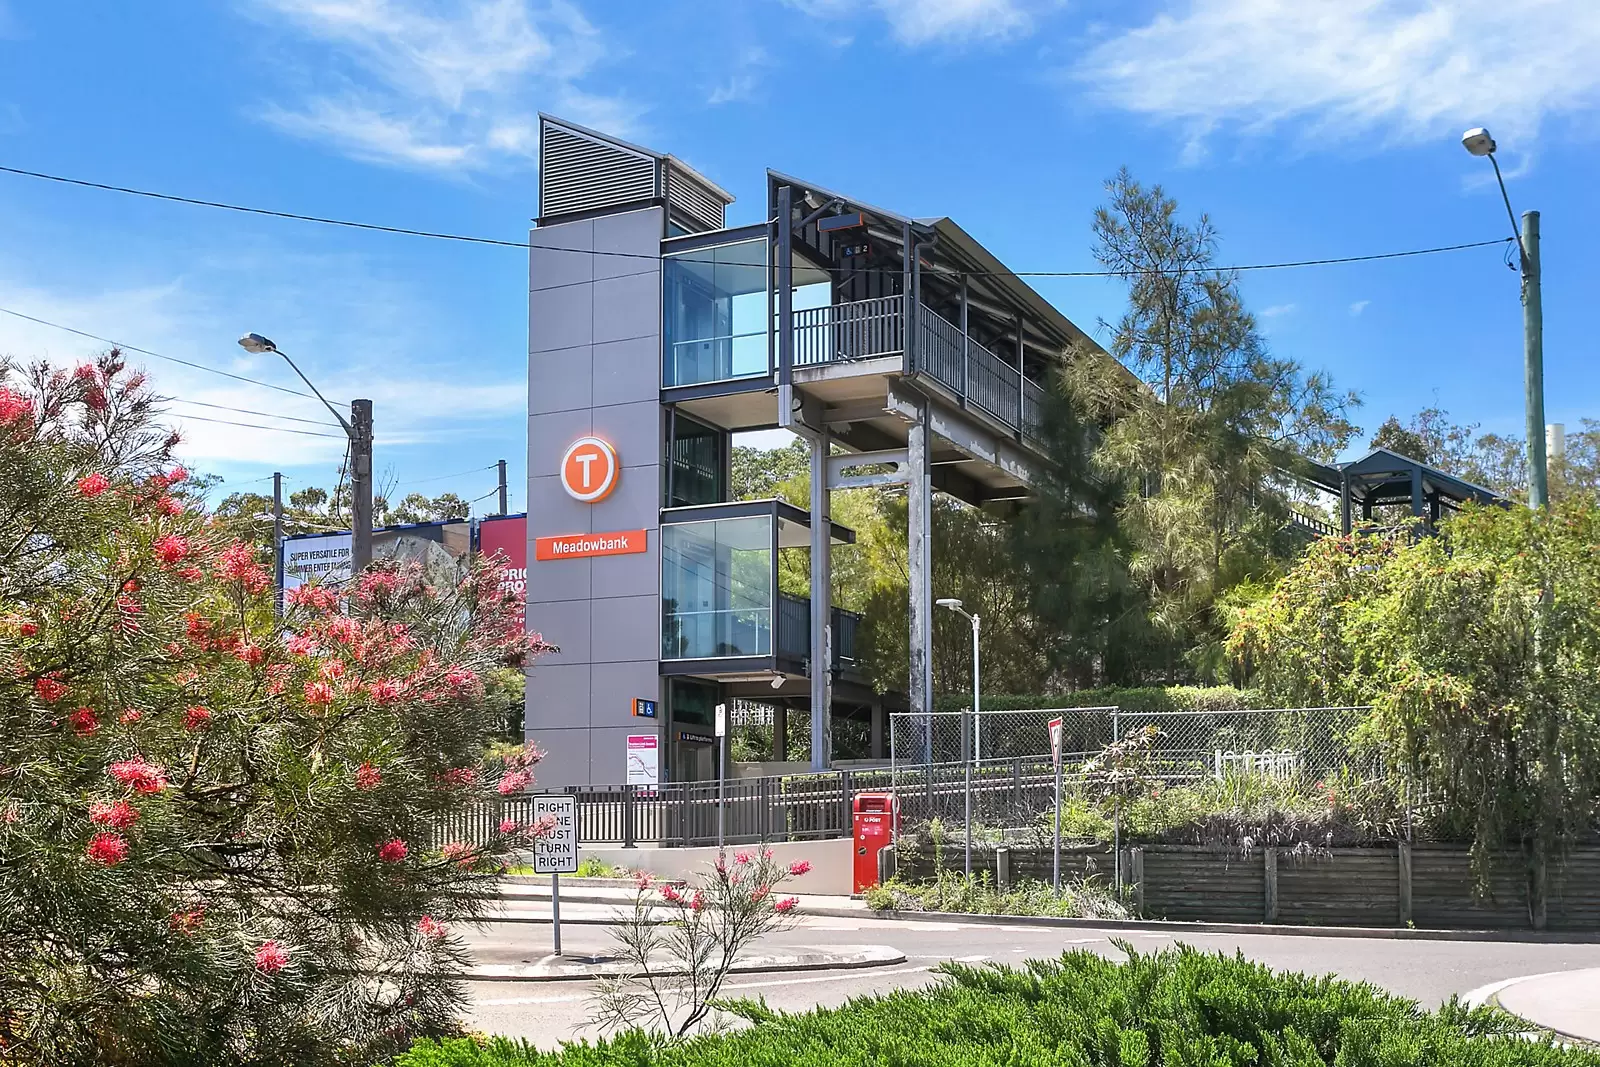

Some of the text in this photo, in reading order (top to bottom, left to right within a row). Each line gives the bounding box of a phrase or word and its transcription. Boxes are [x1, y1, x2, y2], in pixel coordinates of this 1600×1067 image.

[575, 453, 598, 488] T
[553, 536, 628, 554] Meadowbank
[290, 548, 350, 561] SUPER VERSATILE FOR
[497, 580, 527, 592] PRO
[538, 803, 571, 812] RIGHT
[539, 817, 571, 826] NE
[540, 843, 570, 853] TURN
[539, 857, 572, 867] RIGHT
